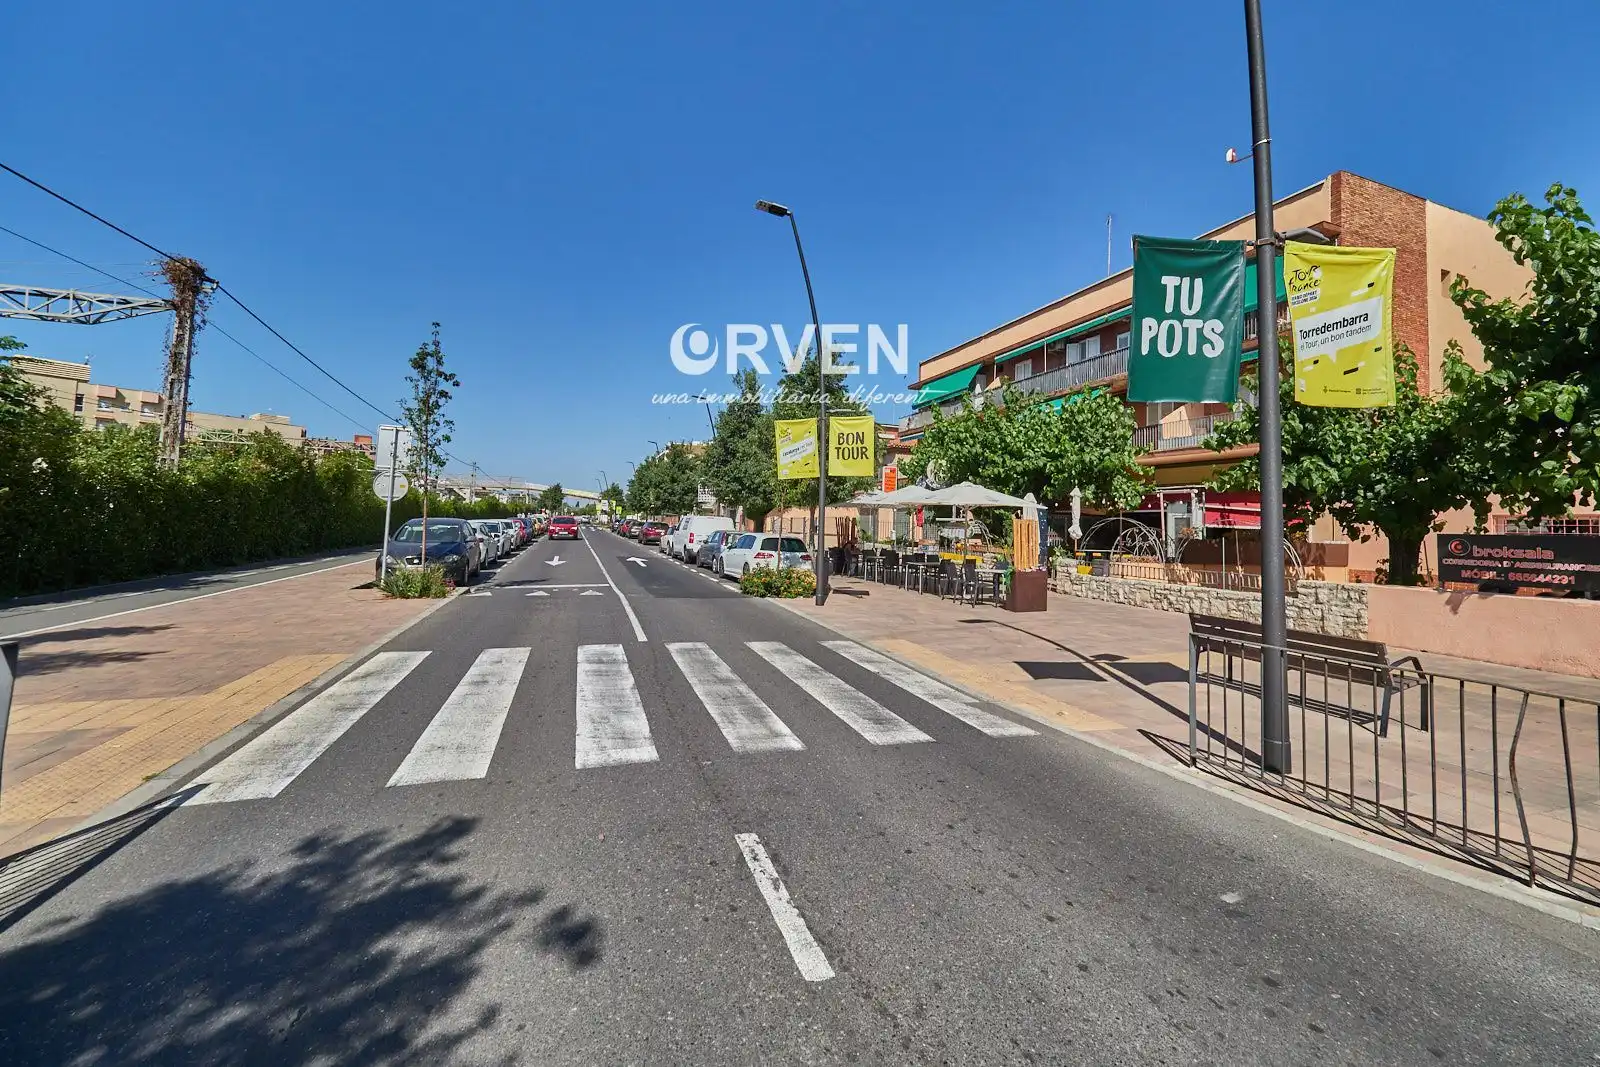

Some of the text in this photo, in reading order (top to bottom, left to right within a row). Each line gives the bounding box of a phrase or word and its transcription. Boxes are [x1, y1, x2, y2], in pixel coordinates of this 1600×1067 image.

[1161, 275, 1203, 316] TU
[1141, 317, 1225, 358] POTS
[1299, 312, 1369, 341] Torredembarra
[1305, 340, 1320, 348] Tour,
[1320, 337, 1330, 345] un
[1330, 331, 1345, 342] bon
[1345, 324, 1372, 338] tandem
[837, 432, 865, 446] BON
[834, 446, 869, 461] TOUR
[1472, 545, 1555, 560] broksala
